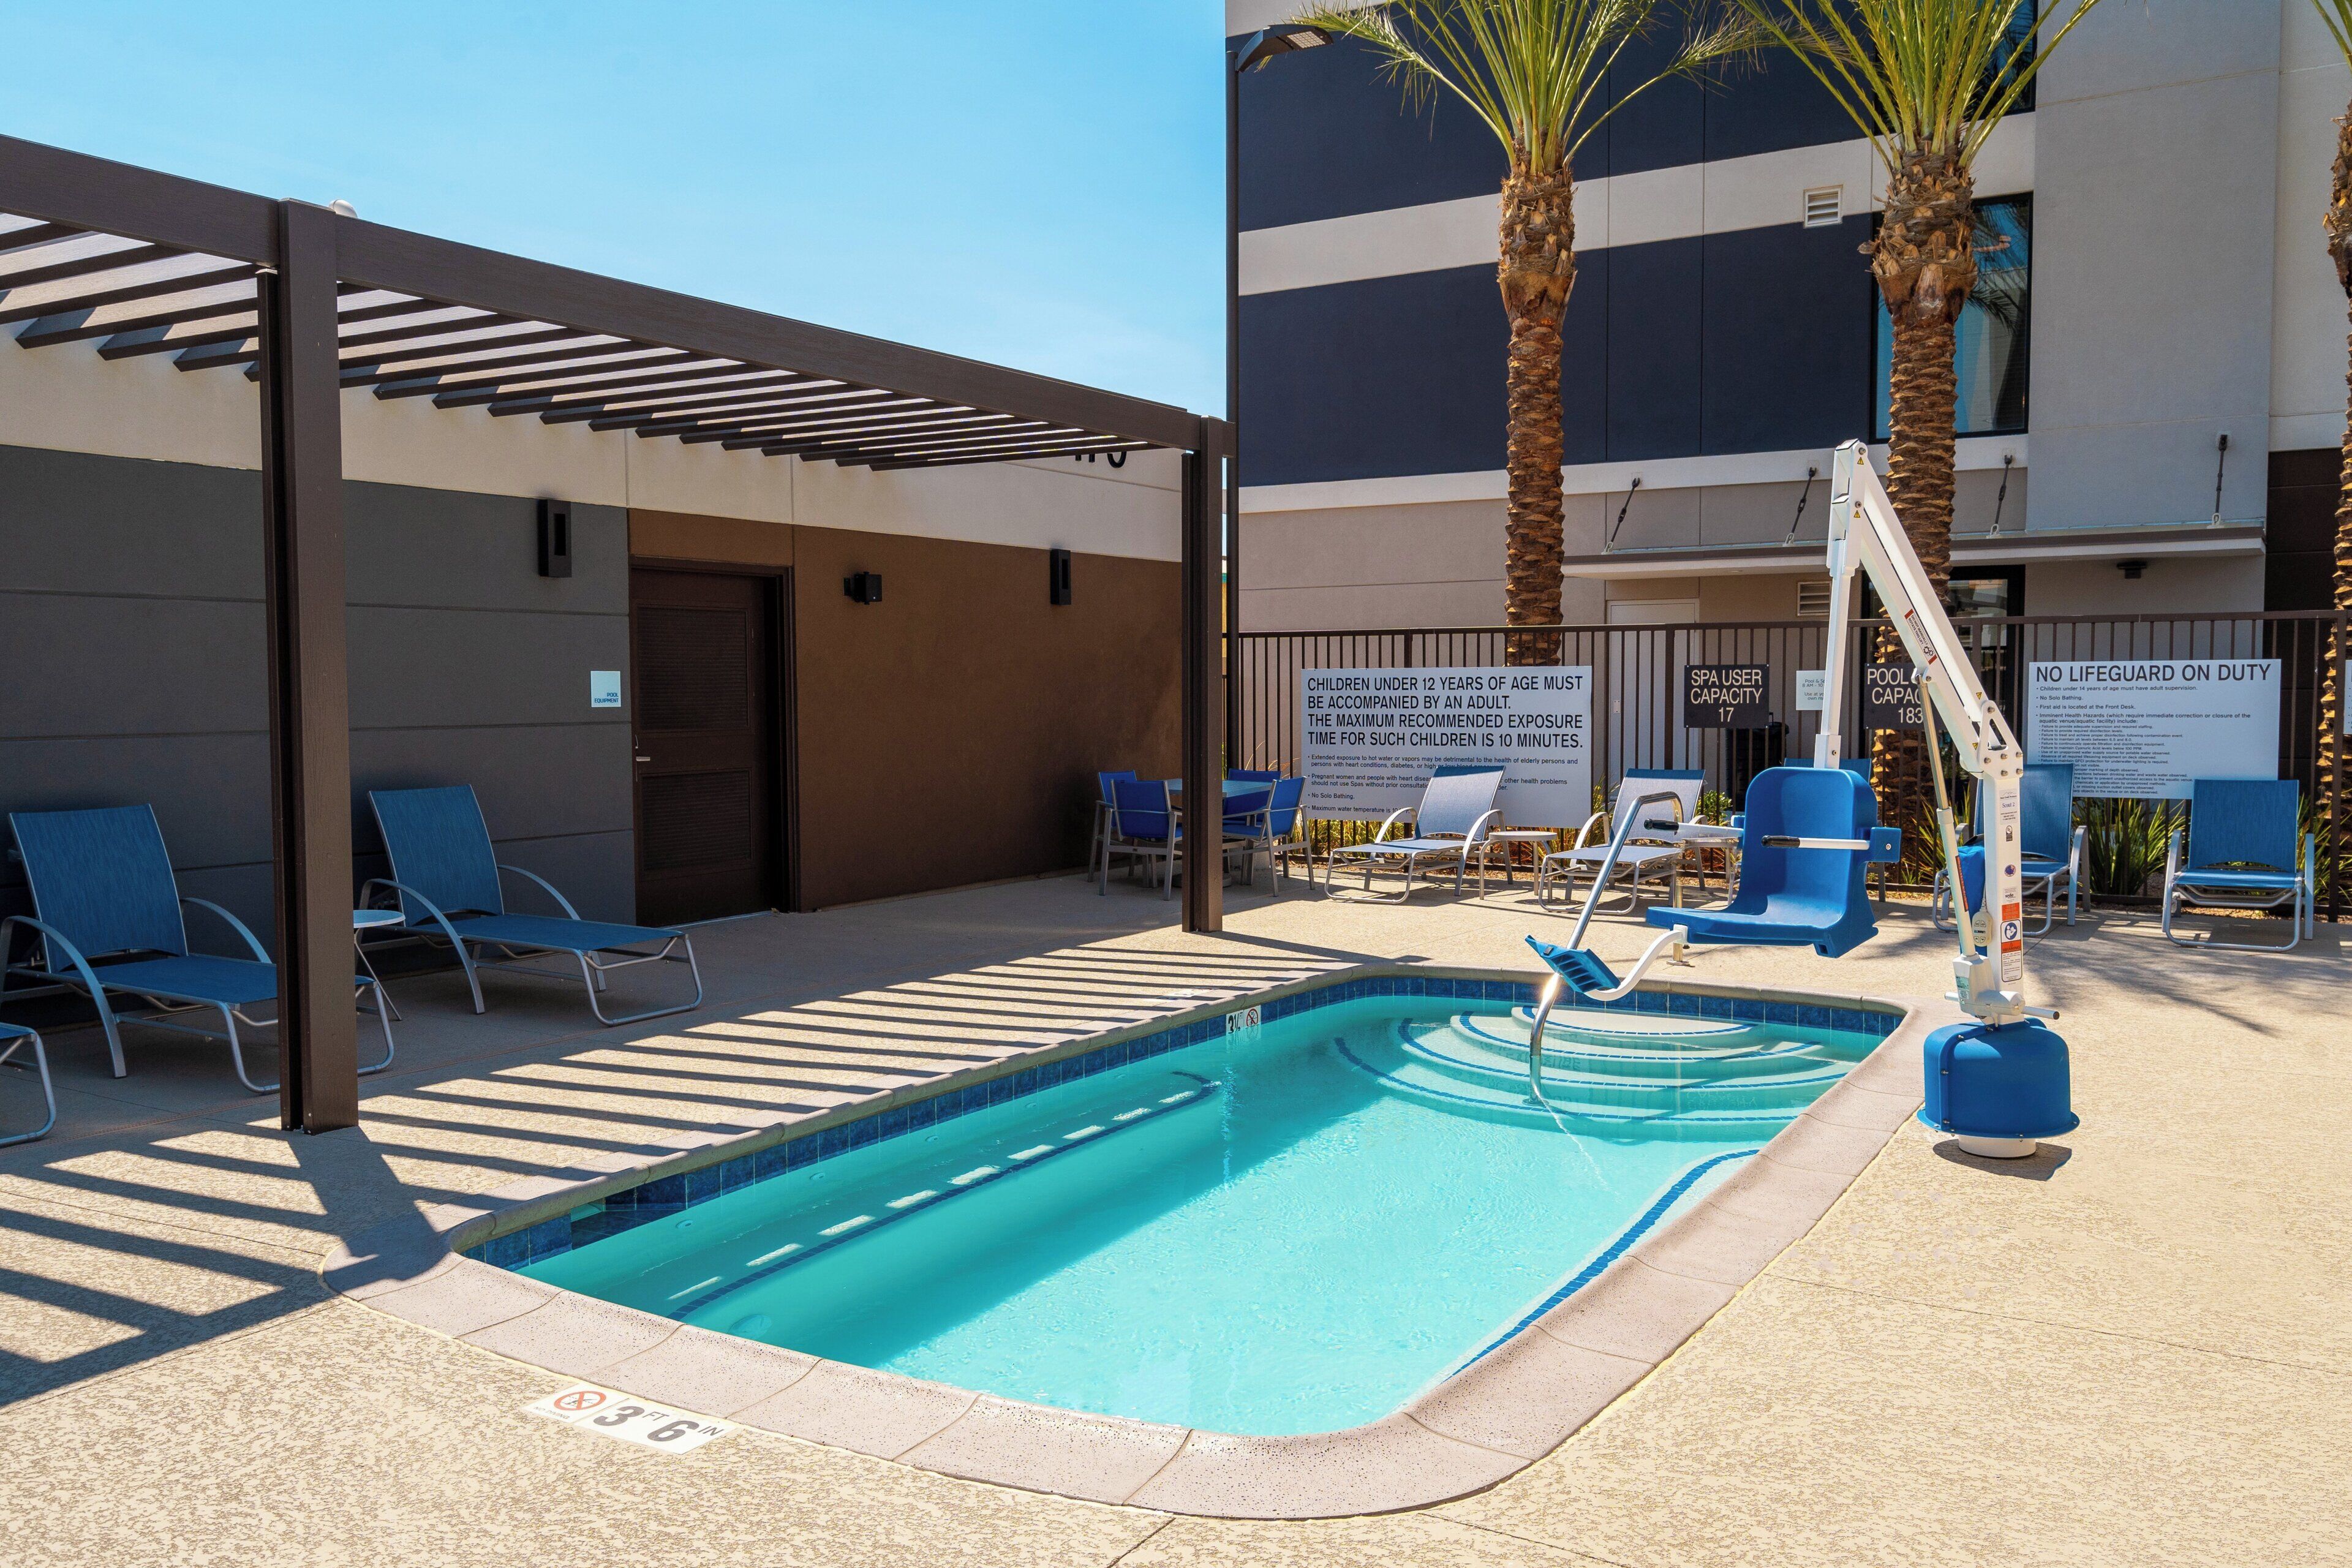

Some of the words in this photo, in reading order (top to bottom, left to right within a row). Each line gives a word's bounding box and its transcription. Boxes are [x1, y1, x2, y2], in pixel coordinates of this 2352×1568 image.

[1918, 627, 1928, 645] MANUALLY
[1692, 670, 1719, 685] SPA
[1722, 669, 1762, 685] USER
[1868, 668, 1909, 685] POOL
[2037, 666, 2062, 682] NO
[2070, 665, 2174, 682] LIFEGUARD
[2182, 665, 2209, 681] ON
[2218, 664, 2271, 681] DUTY
[1308, 677, 1369, 691] CHILDREN
[1374, 677, 1417, 691] UNDER
[1423, 677, 1434, 690] 12
[1440, 676, 1483, 690] YEARS
[1488, 676, 1506, 690] OF
[1511, 676, 1539, 690] AGE
[1545, 676, 1583, 690] MUST
[1308, 696, 1324, 709] BE
[1328, 695, 1419, 709] ACCOMPANIED
[1424, 696, 1440, 709] BY
[1444, 696, 1461, 709] AN
[1467, 695, 1510, 709] ADULT.
[1691, 688, 1762, 704] CAPACITY
[1308, 714, 1332, 726] THE
[1336, 714, 1393, 727] MAXIMUM
[1400, 714, 1503, 728] RECOMMENDED
[1509, 714, 1582, 728] EXPOSURE
[1719, 707, 1733, 722] 17
[1899, 707, 1923, 724] 183
[1308, 732, 1336, 745] TIME
[1341, 732, 1365, 745] FOR
[1370, 732, 1404, 745] SUCH
[1410, 733, 1476, 747] CHILDREN
[1482, 733, 1494, 747] IS
[1499, 734, 1512, 747] 10
[1518, 734, 1583, 748] MINUTES.
[547, 1411, 570, 1419] DIVING
[594, 1406, 645, 1427] 3
[642, 1411, 669, 1422] FT
[647, 1420, 699, 1442] 6
[698, 1426, 724, 1436] IN
